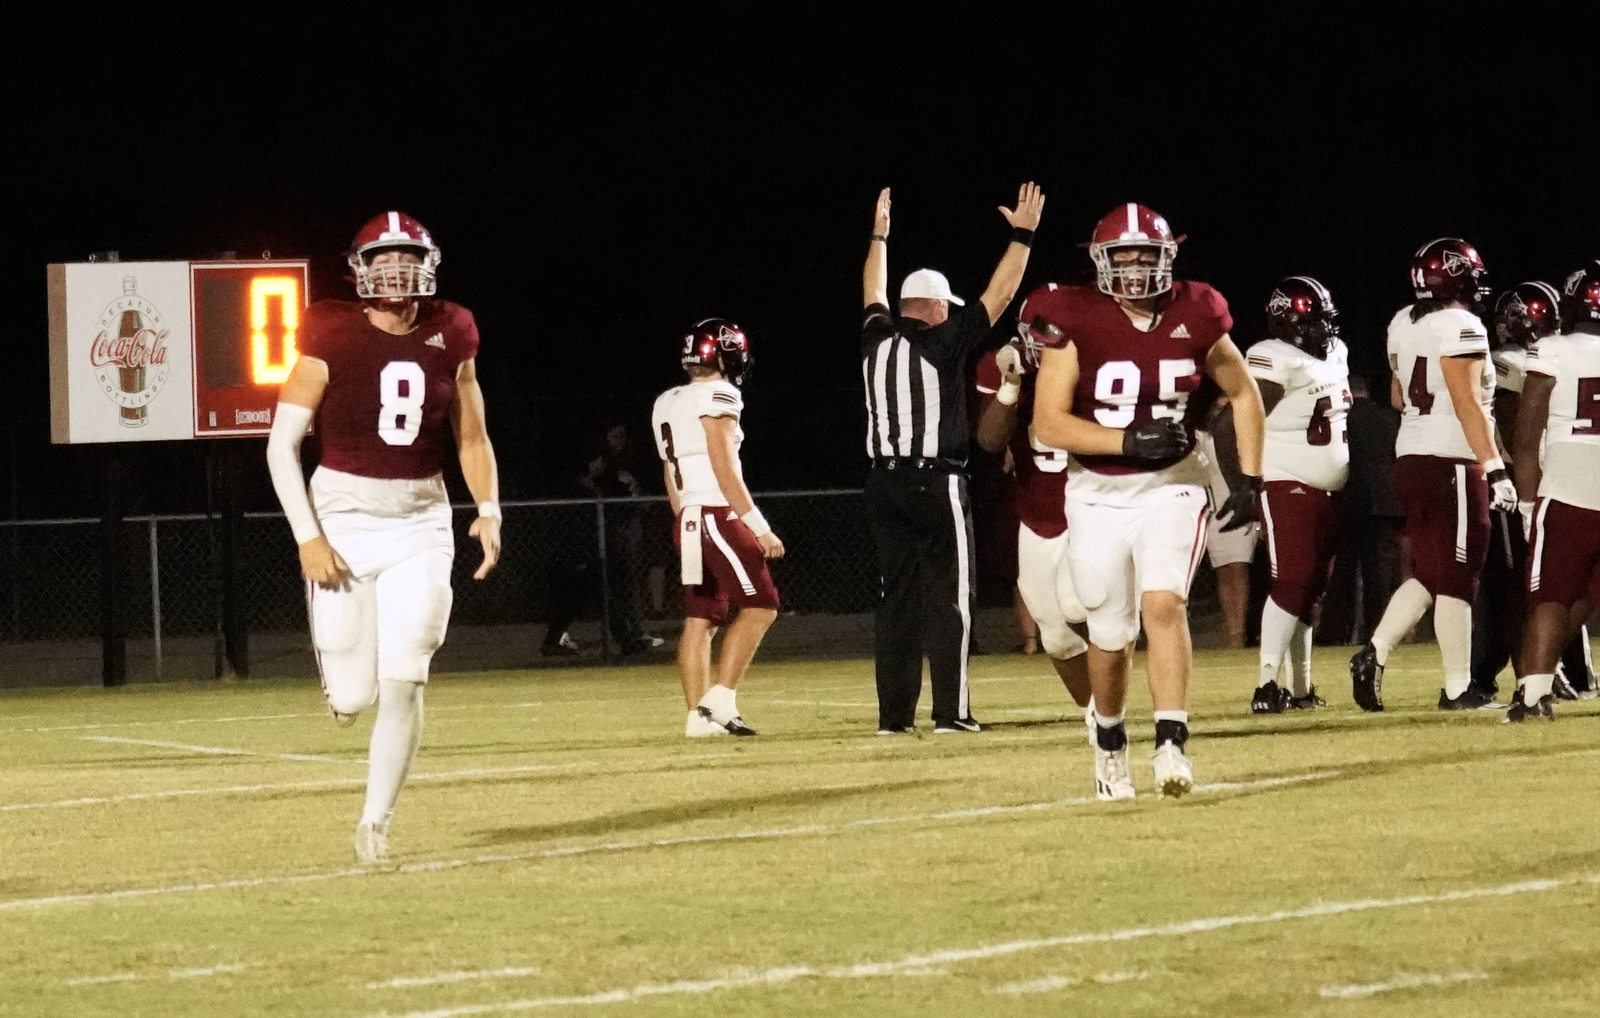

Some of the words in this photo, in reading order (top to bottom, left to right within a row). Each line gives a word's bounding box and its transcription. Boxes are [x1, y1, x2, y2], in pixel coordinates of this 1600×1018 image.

[101, 300, 160, 326] DECATUR
[249, 276, 300, 385] 0
[90, 329, 169, 368] Coca-Cola
[100, 374, 158, 405] BOTTLING
[378, 361, 425, 446] 8
[1094, 359, 1196, 429] 95
